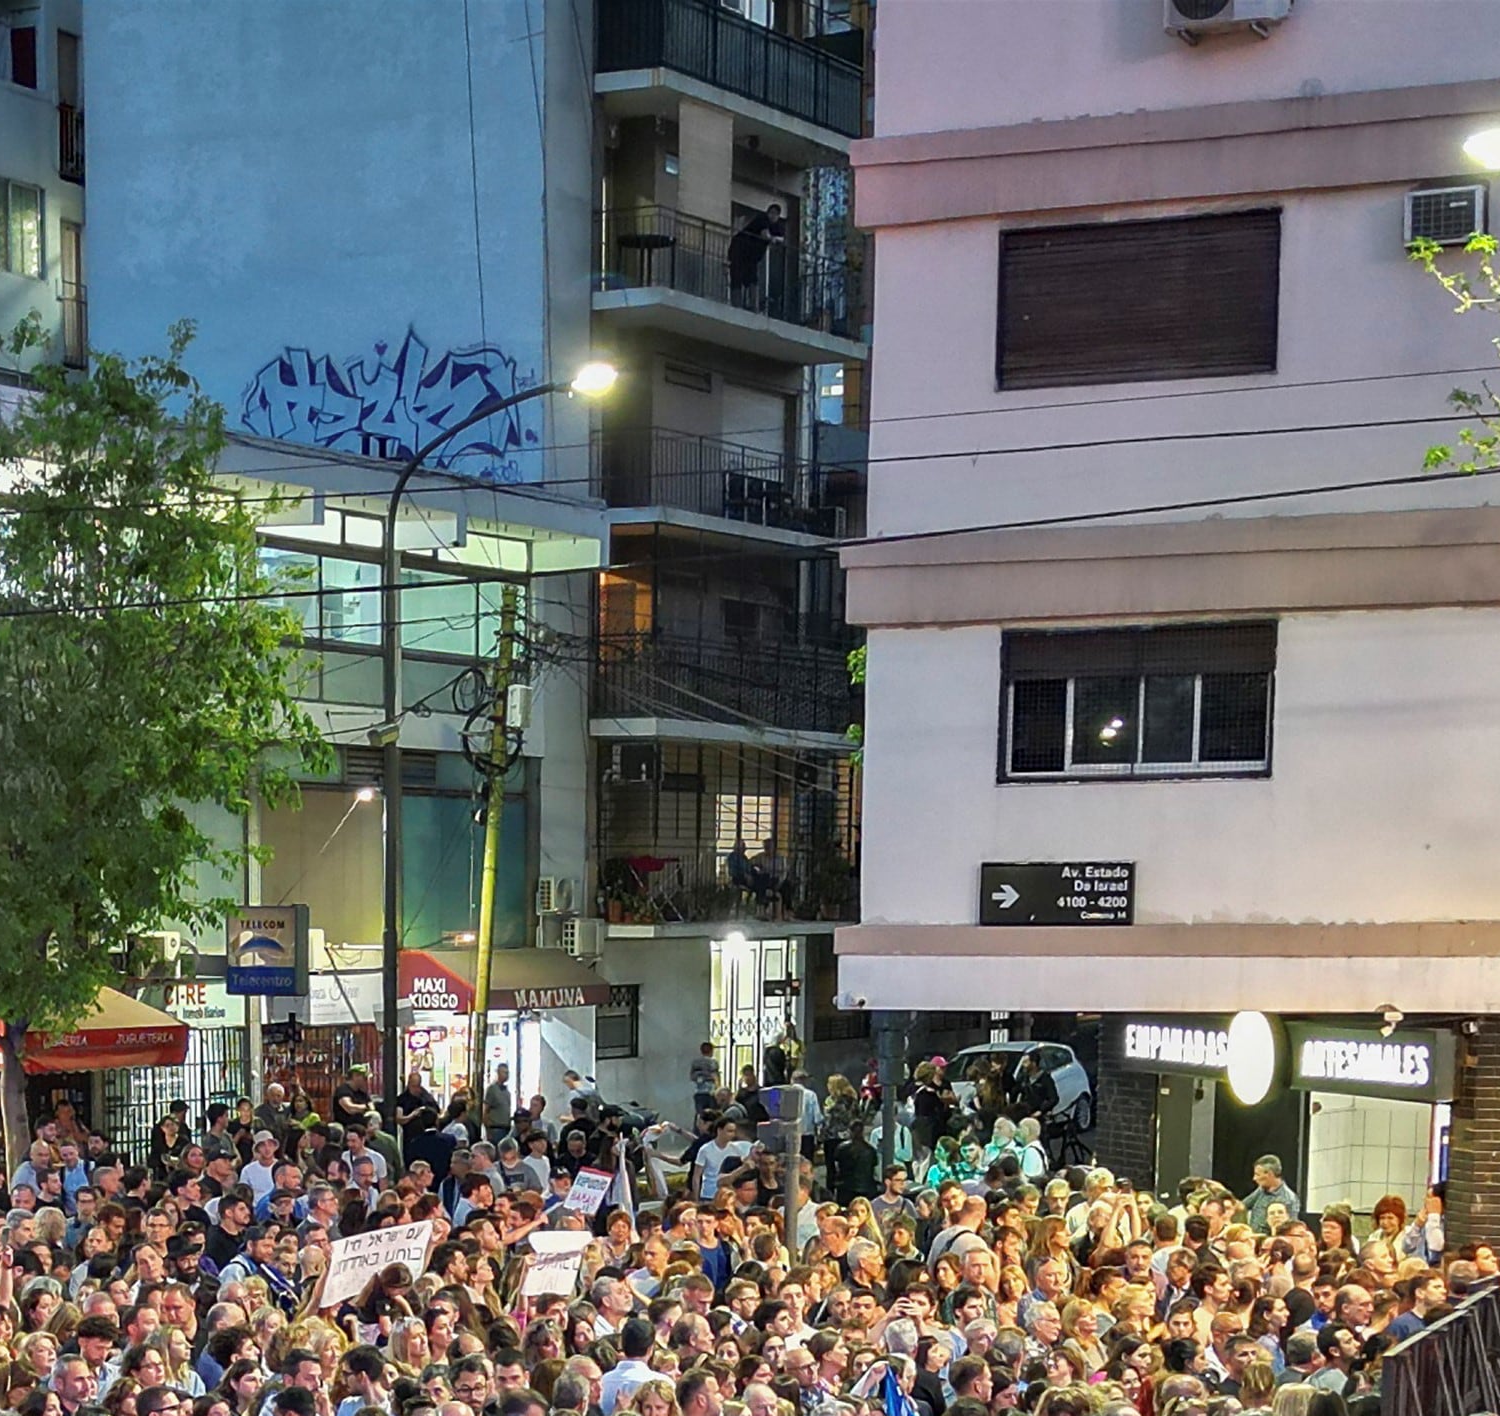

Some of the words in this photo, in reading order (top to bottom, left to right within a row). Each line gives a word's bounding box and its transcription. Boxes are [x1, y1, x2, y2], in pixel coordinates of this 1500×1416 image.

[1062, 866, 1082, 878] Av.
[1085, 866, 1129, 878] Estado
[1074, 880, 1091, 892] De
[1094, 880, 1128, 892] Israel
[1056, 897, 1087, 908] 4100
[1097, 897, 1128, 908] 4200
[241, 919, 285, 929] TELECOM
[232, 973, 293, 987] Telecentro
[414, 977, 446, 993] MAXI
[409, 994, 459, 1009] KIOSCO
[1126, 1024, 1228, 1067] EMPANADAS
[1301, 1040, 1430, 1086] ARTESANALES
